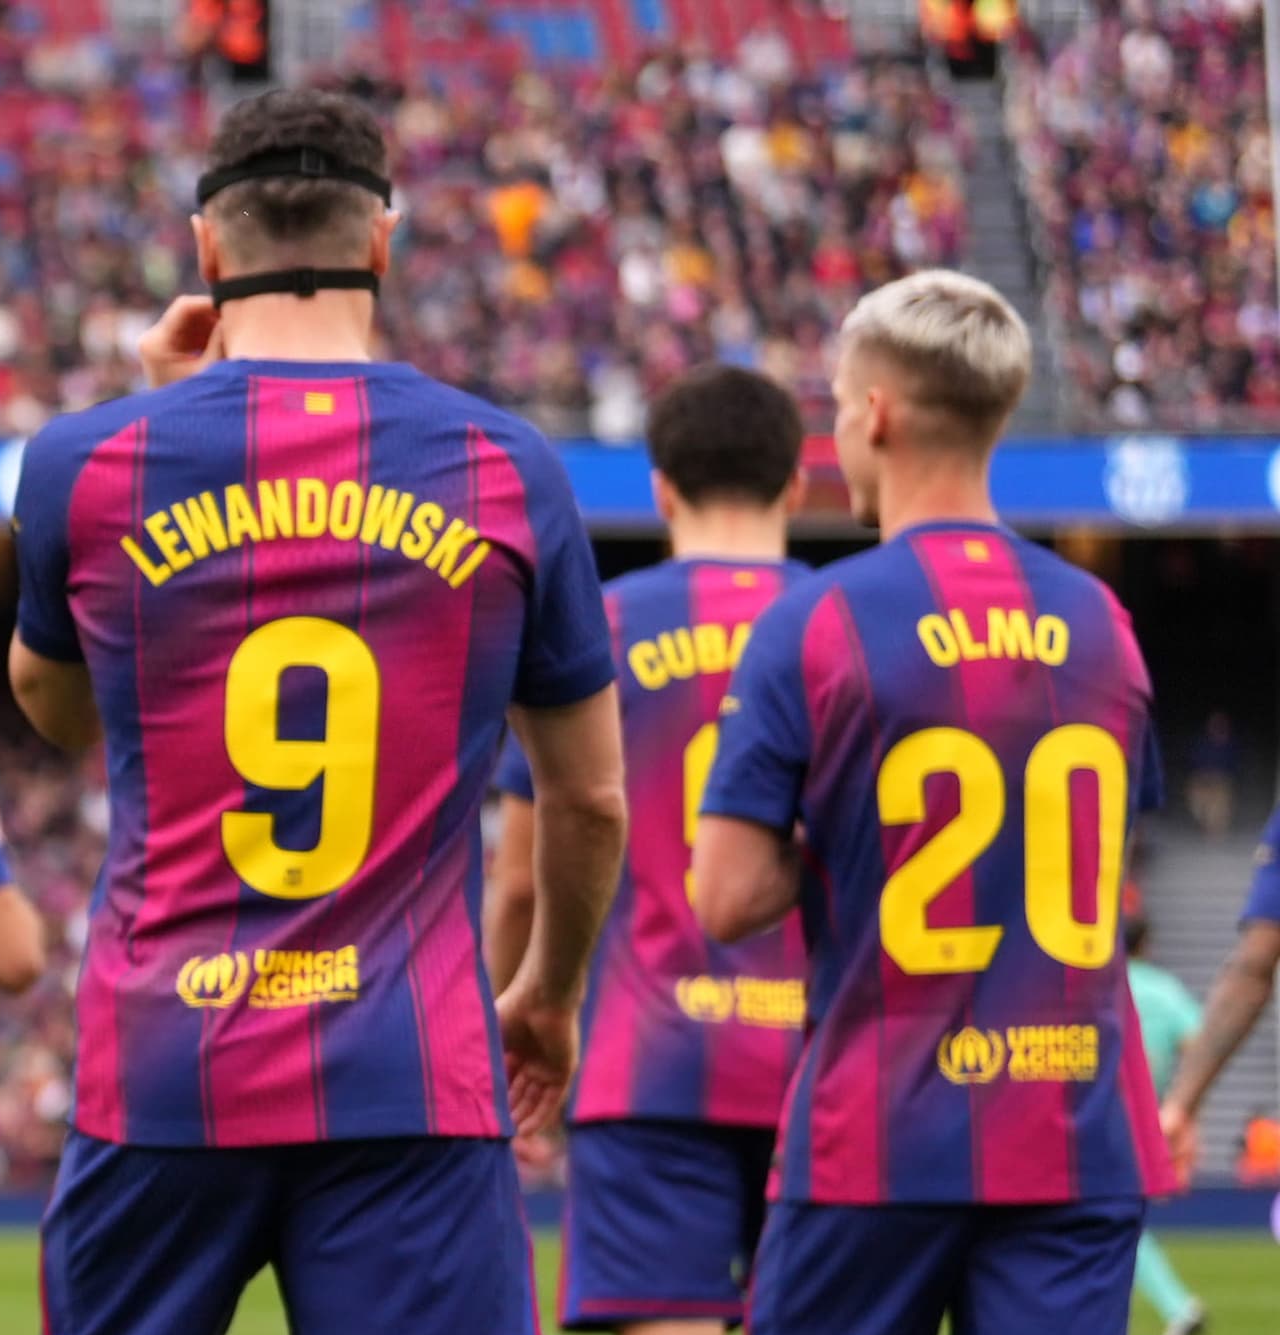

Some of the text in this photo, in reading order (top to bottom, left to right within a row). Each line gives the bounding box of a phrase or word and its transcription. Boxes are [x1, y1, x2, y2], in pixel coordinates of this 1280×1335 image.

[120, 476, 491, 588] LEWANDOWSKI
[917, 607, 1070, 667] OLMO
[221, 616, 380, 899] 9
[877, 723, 1128, 975] 20
[254, 945, 359, 975] UNHCR
